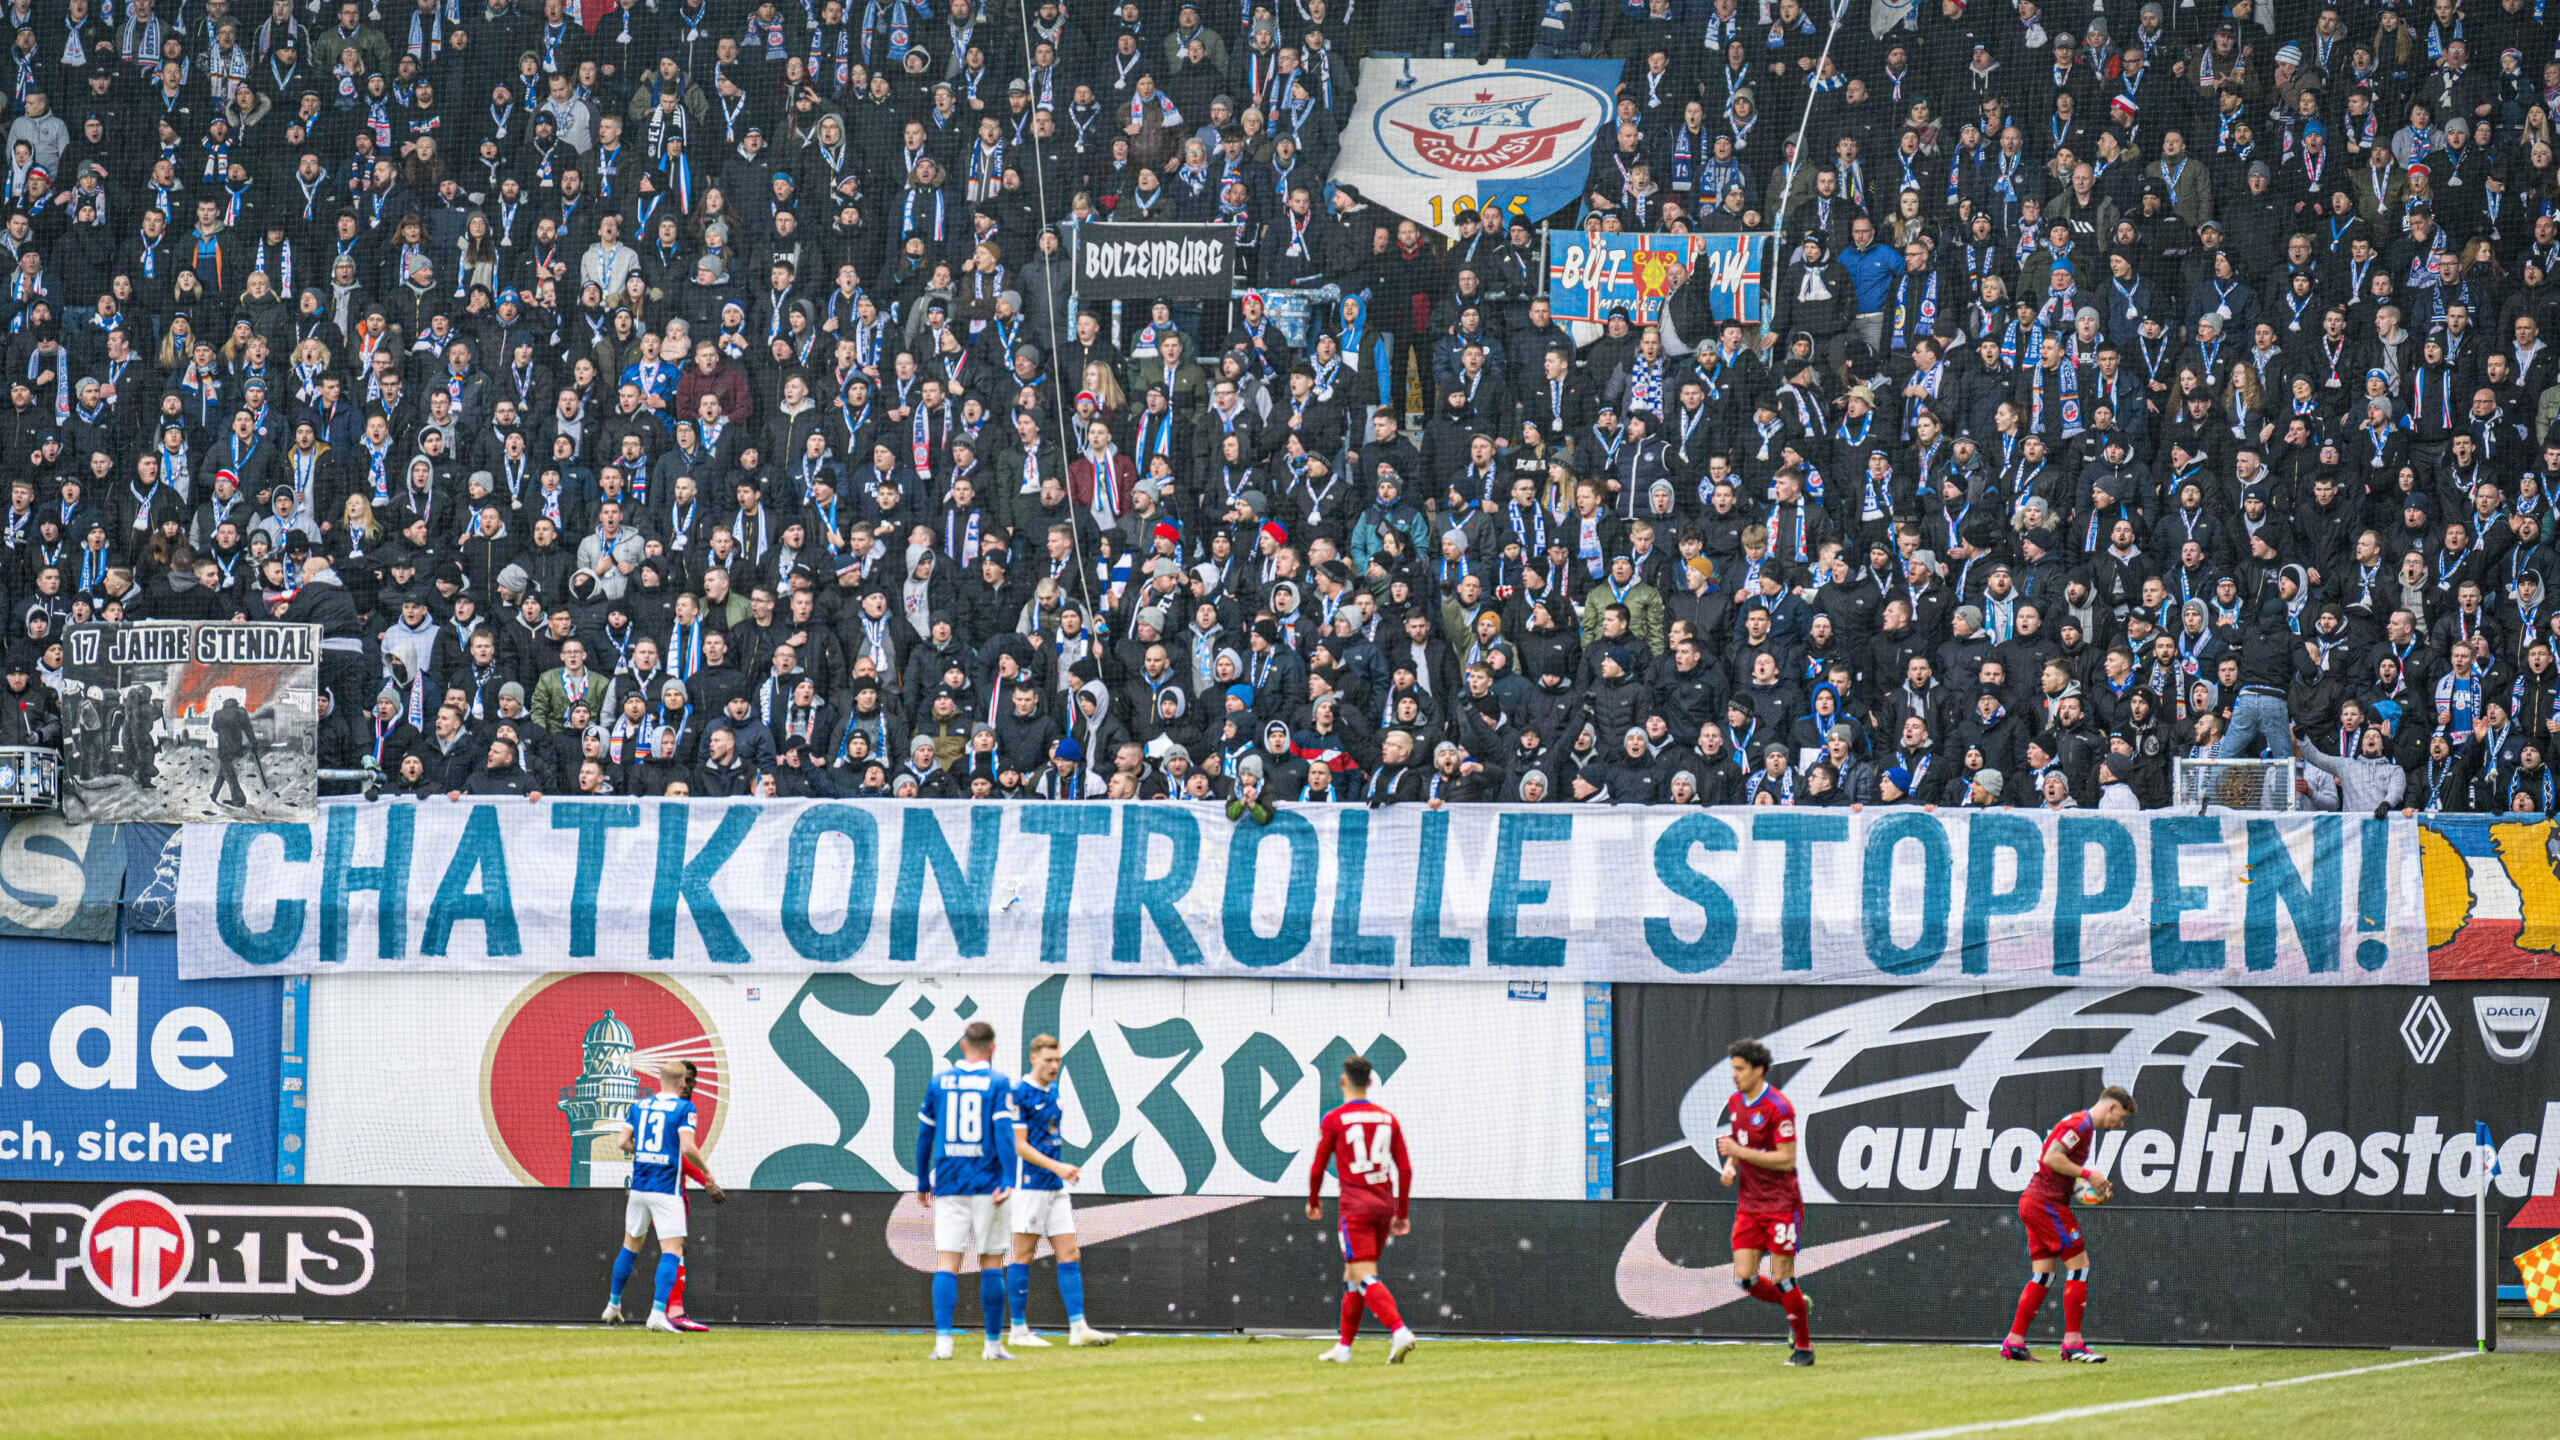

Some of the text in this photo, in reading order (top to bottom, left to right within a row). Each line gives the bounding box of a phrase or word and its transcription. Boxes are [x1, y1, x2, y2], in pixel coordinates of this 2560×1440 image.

[1451, 135, 1535, 168] HANSA
[1085, 235, 1224, 281] BOIZENBURG
[71, 626, 312, 665] 17 JAHRE STENDAL
[216, 801, 1572, 967] CHATKONTROLLE
[1644, 810, 2389, 975] STOPPEN!
[2486, 1006, 2536, 1017] DACIA
[0, 977, 234, 1091] .de
[637, 1110, 665, 1152] 13
[946, 1091, 982, 1142] 18
[77, 1119, 232, 1163] sicher
[1345, 1123, 1392, 1175] 14
[1774, 1222, 1796, 1245] 34
